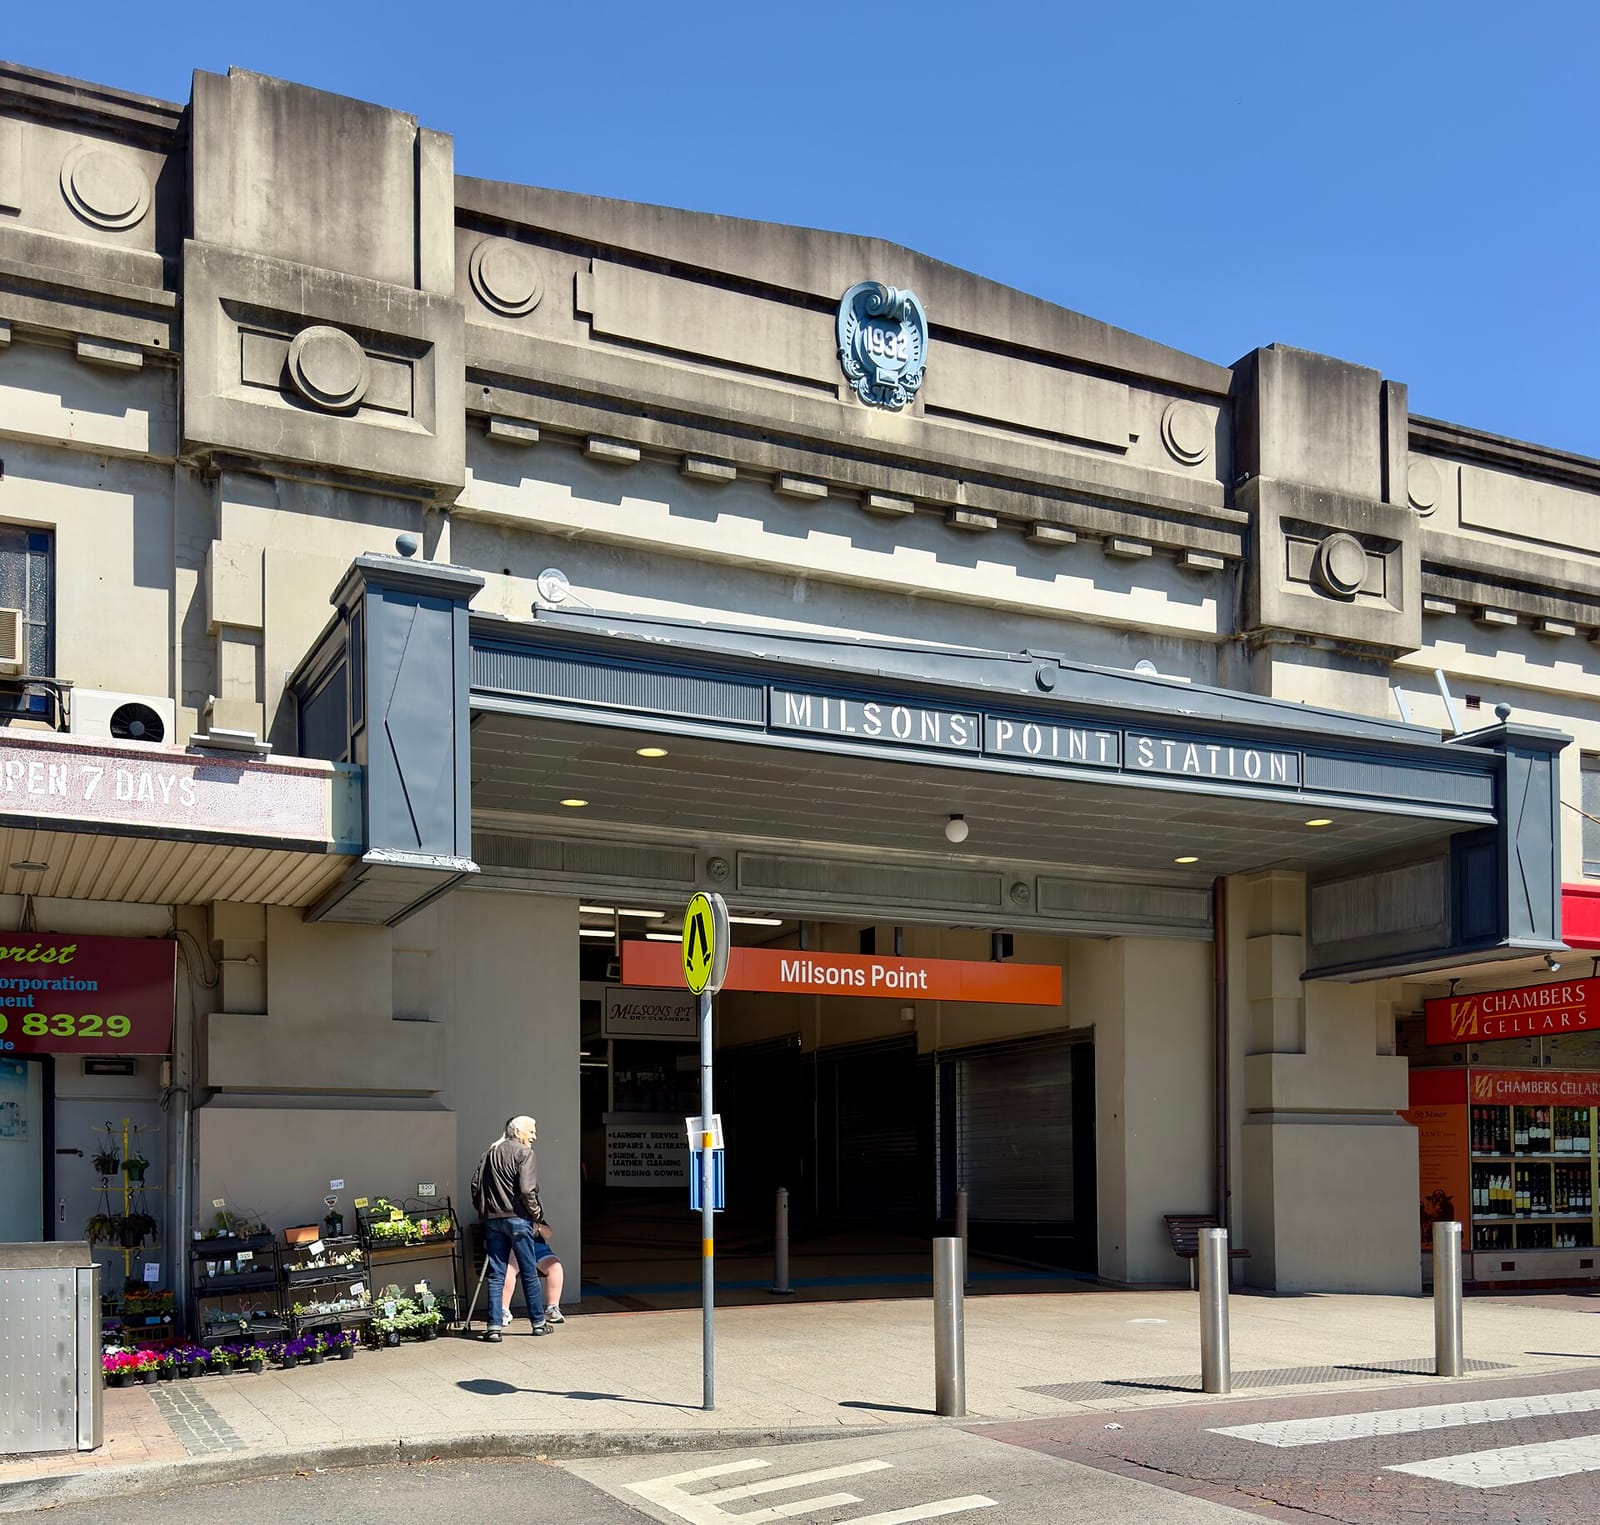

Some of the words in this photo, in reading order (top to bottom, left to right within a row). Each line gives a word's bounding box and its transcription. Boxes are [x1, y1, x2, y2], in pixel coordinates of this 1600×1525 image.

[866, 326, 908, 361] 1932
[785, 692, 967, 746] MILSONS
[996, 720, 1111, 762] POINT
[1138, 737, 1287, 782] STATION
[0, 760, 67, 797] PEN
[80, 765, 104, 800] 7
[115, 767, 197, 807] DAYS
[780, 959, 866, 987] Milsons
[871, 965, 928, 989] Point
[0, 994, 35, 1008] ent
[610, 1003, 673, 1020] MILSONS
[1482, 984, 1586, 1013] CHAMBERS
[22, 1013, 132, 1038] 8329
[1483, 1011, 1587, 1035] CELLARS
[1496, 1080, 1558, 1094] CHAMBERS
[1560, 1081, 1600, 1095] CELLAR
